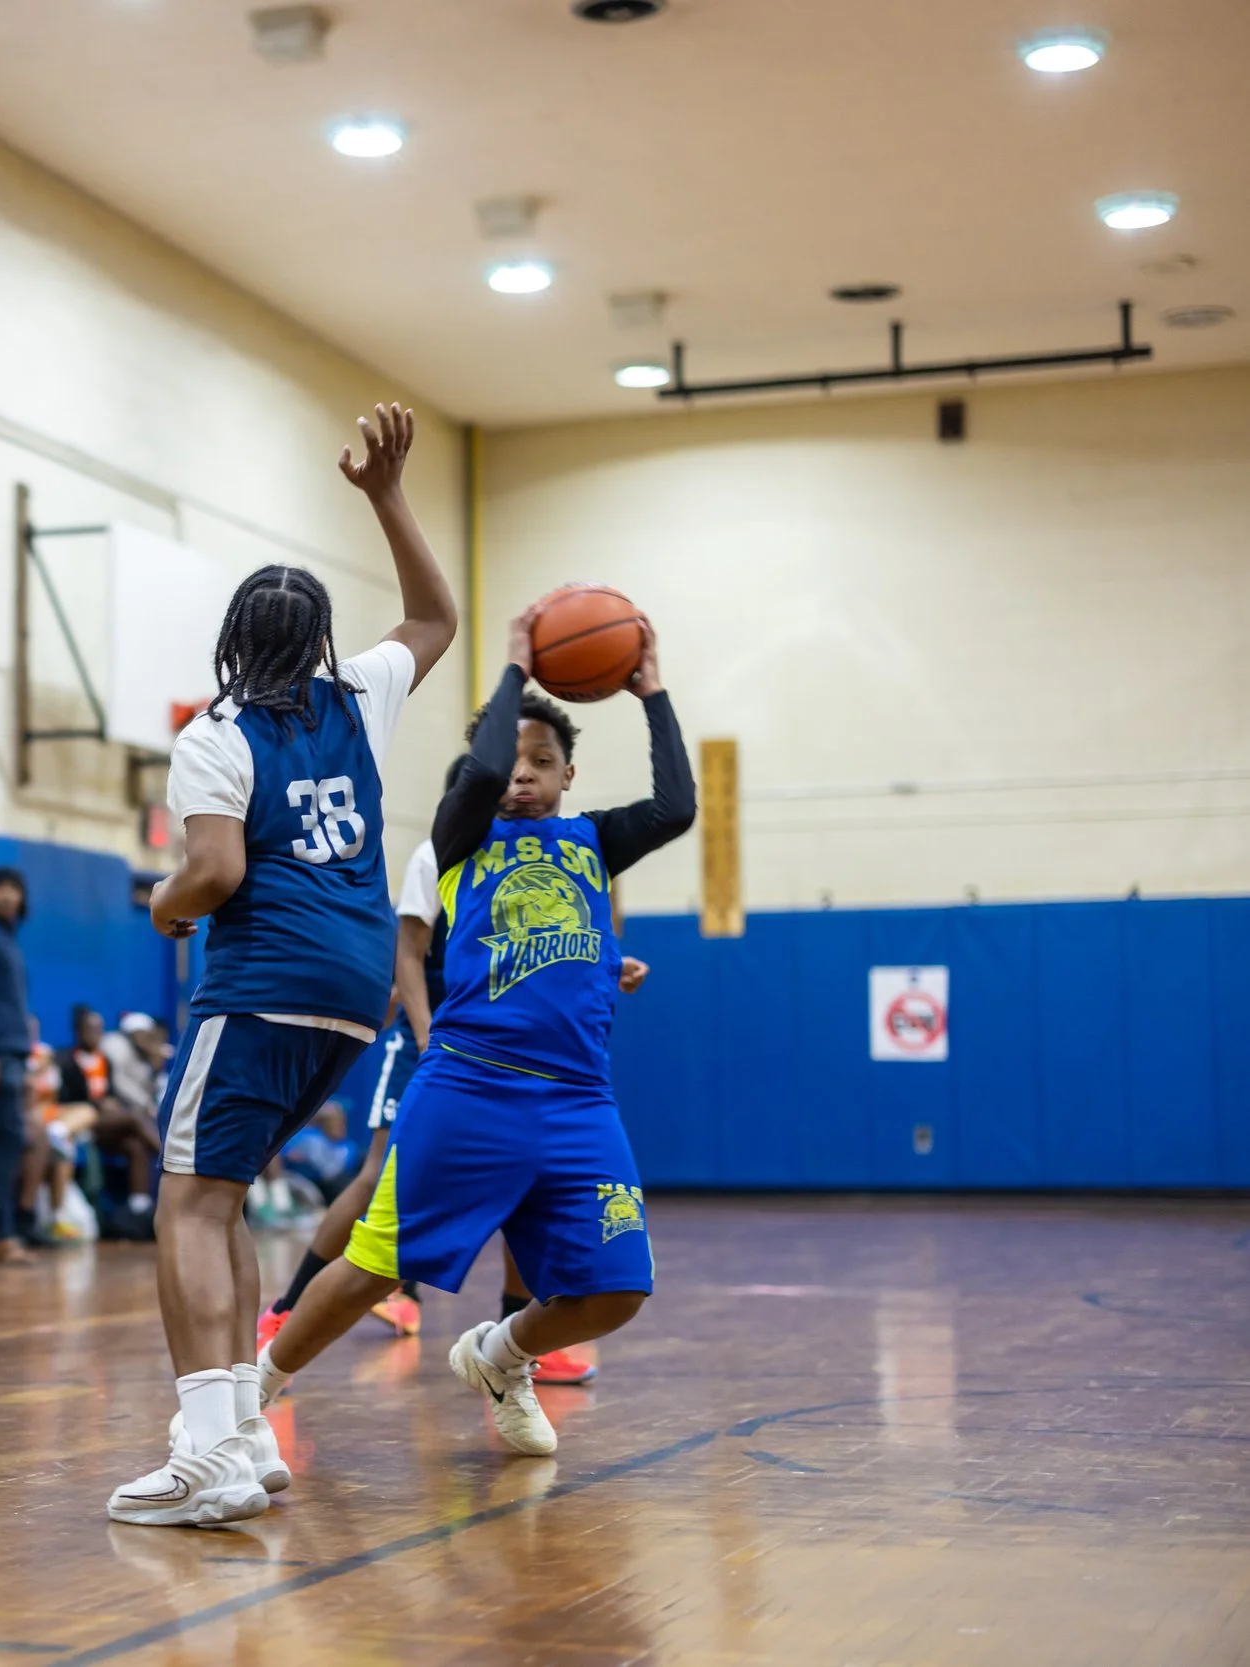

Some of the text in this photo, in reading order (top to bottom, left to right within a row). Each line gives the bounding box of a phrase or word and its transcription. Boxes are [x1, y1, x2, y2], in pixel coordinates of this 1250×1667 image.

[286, 775, 365, 864] 38
[472, 836, 602, 893] M.S. 50
[478, 931, 602, 1001] WARRIORS
